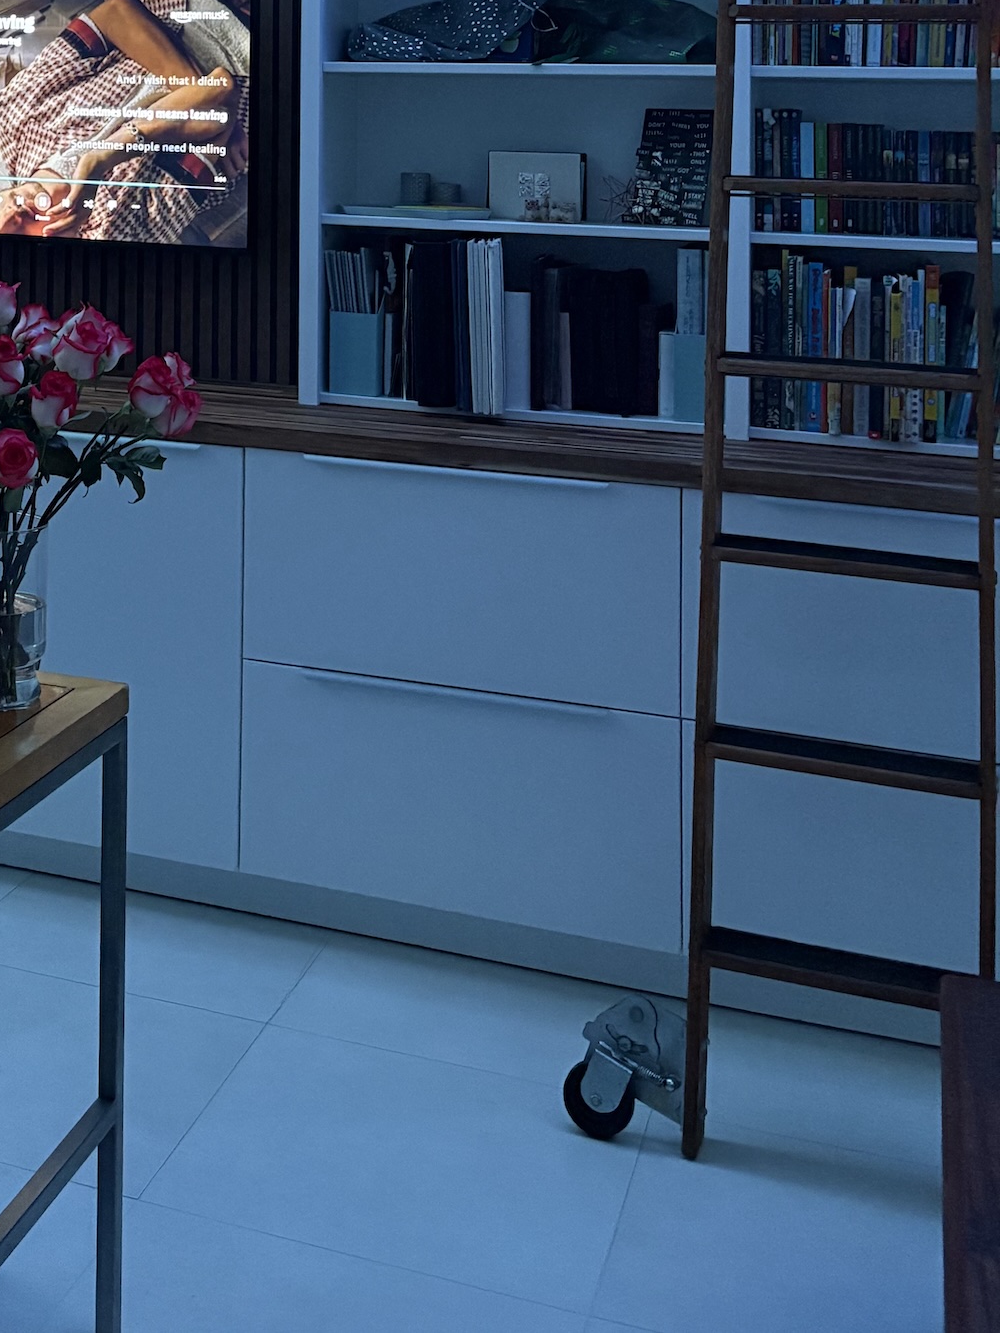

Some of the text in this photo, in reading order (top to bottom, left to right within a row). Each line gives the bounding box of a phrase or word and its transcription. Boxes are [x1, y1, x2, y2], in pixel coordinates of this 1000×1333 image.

[170, 10, 230, 23] amazon music
[116, 75, 137, 85] And
[143, 75, 166, 85] wish
[168, 76, 190, 86] that
[197, 76, 228, 87] didn't
[66, 106, 229, 124] Sometimes loving means leaving
[71, 139, 227, 156] Sometimes people need healing
